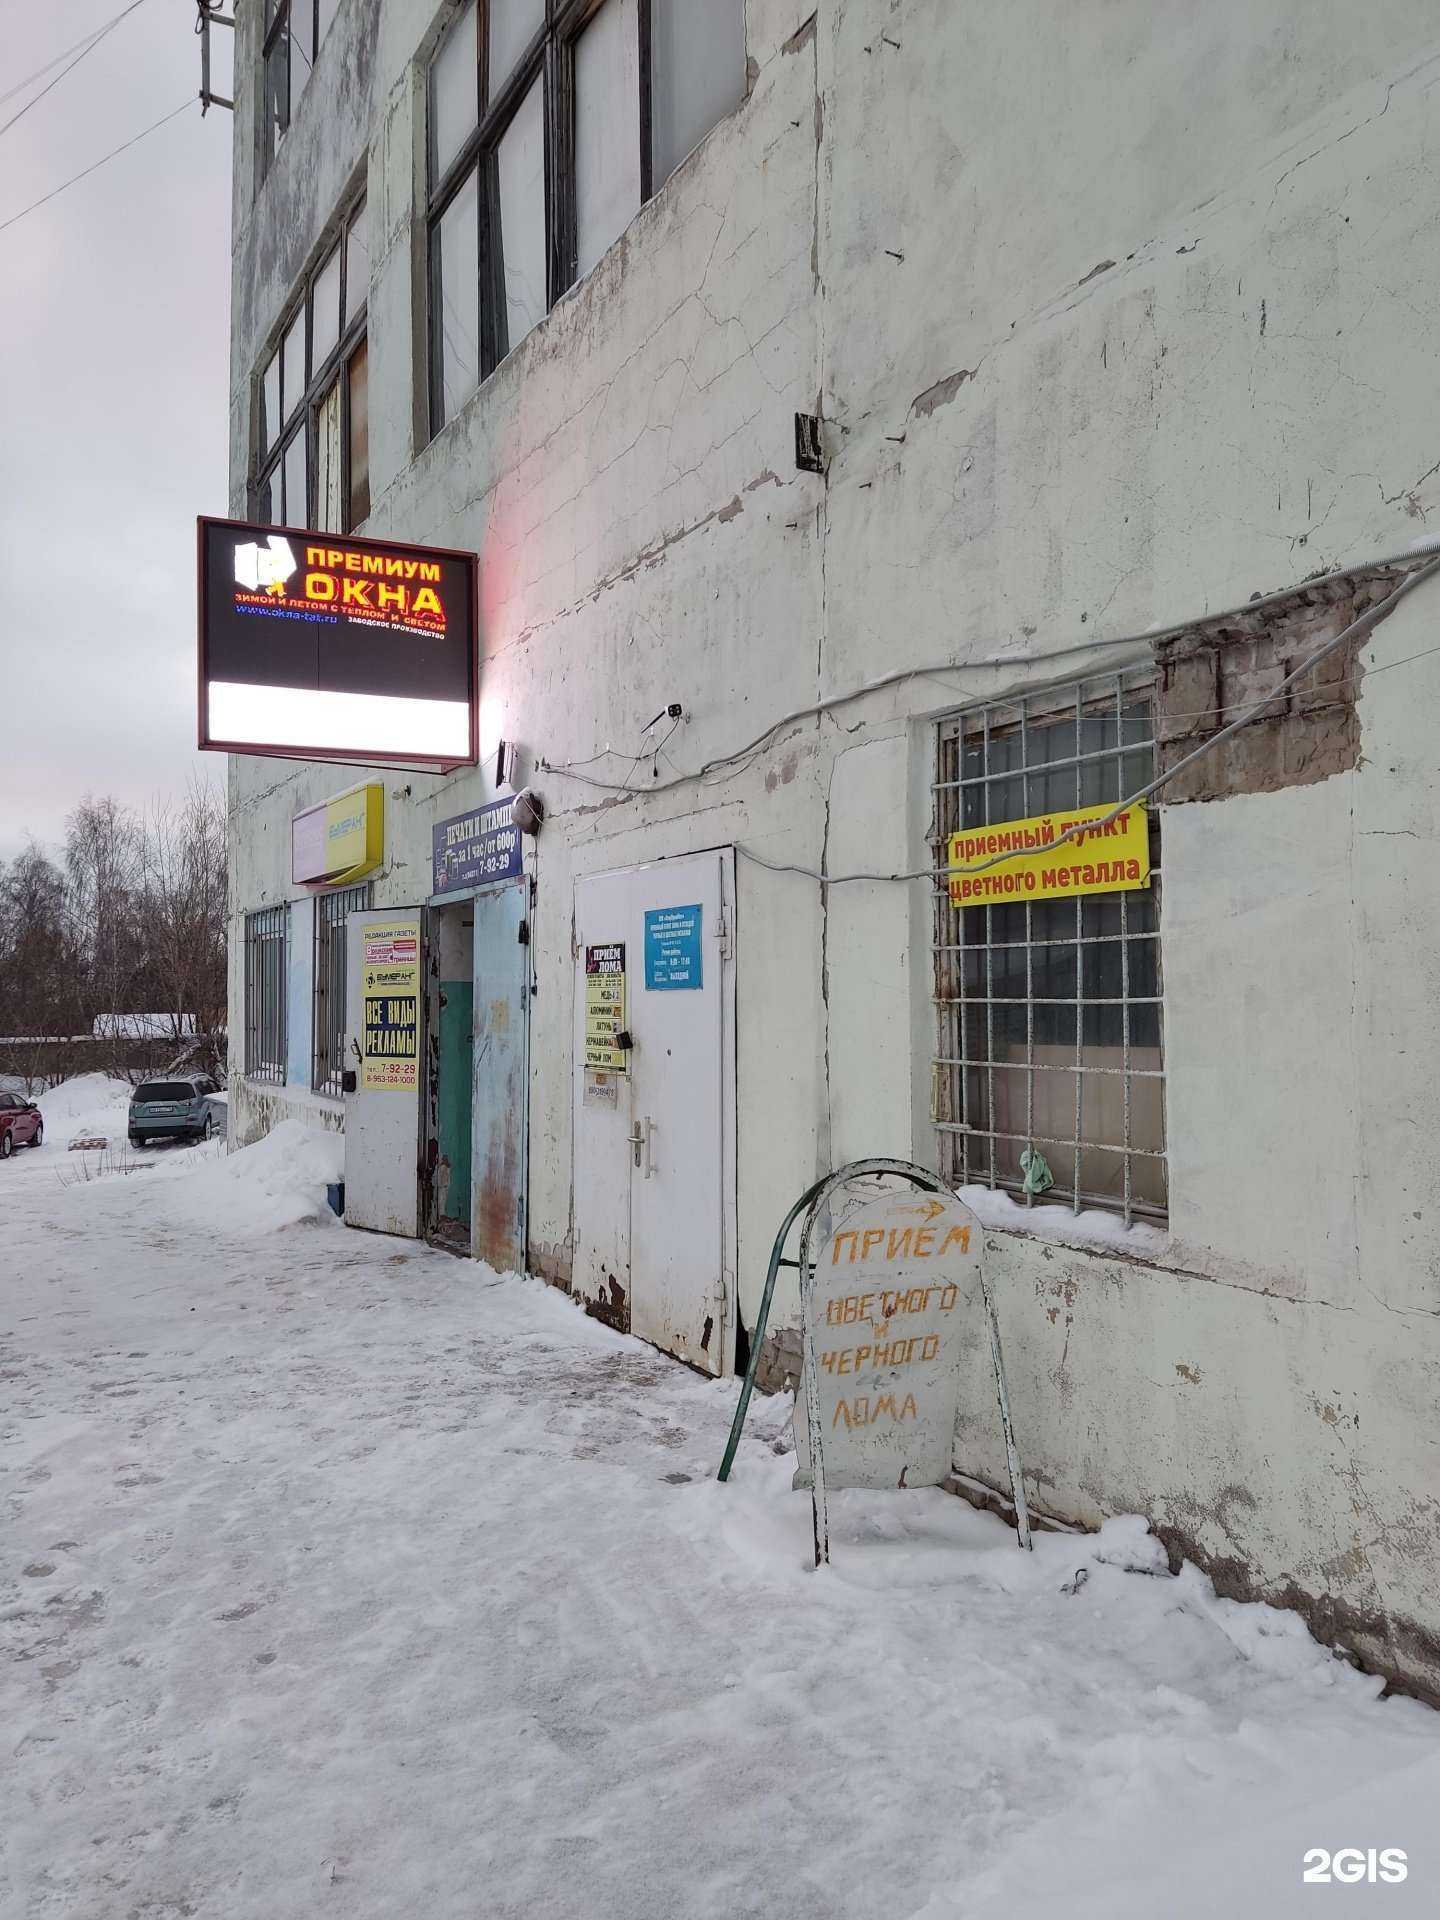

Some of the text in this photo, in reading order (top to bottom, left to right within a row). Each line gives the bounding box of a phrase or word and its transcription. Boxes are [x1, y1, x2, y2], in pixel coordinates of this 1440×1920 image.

[306, 547, 441, 582] ПРЕМИУМ
[305, 572, 443, 616] ОКНА
[278, 598, 286, 606] И
[289, 599, 328, 611] ЛЕТОМ
[330, 603, 338, 612] С
[341, 606, 385, 619] ТЕПЛОМ
[391, 613, 399, 622] И
[447, 818, 474, 846] ПЕЧАТИ
[954, 819, 1054, 863] приемный
[479, 853, 510, 875] 7-92-29
[950, 858, 1141, 901] цветного металла
[593, 944, 621, 961] ПРИЁМ
[599, 960, 622, 972] ЛОМА
[366, 999, 416, 1028] ВСЕ ВИДЫ
[366, 1030, 416, 1056] РЕКЛАМЫ
[381, 1063, 416, 1074] 7-92-29
[832, 1224, 972, 1265] ПРИЕМ
[821, 1333, 940, 1376] ЧЕРНОГО
[832, 1392, 917, 1431] ЛОМА
